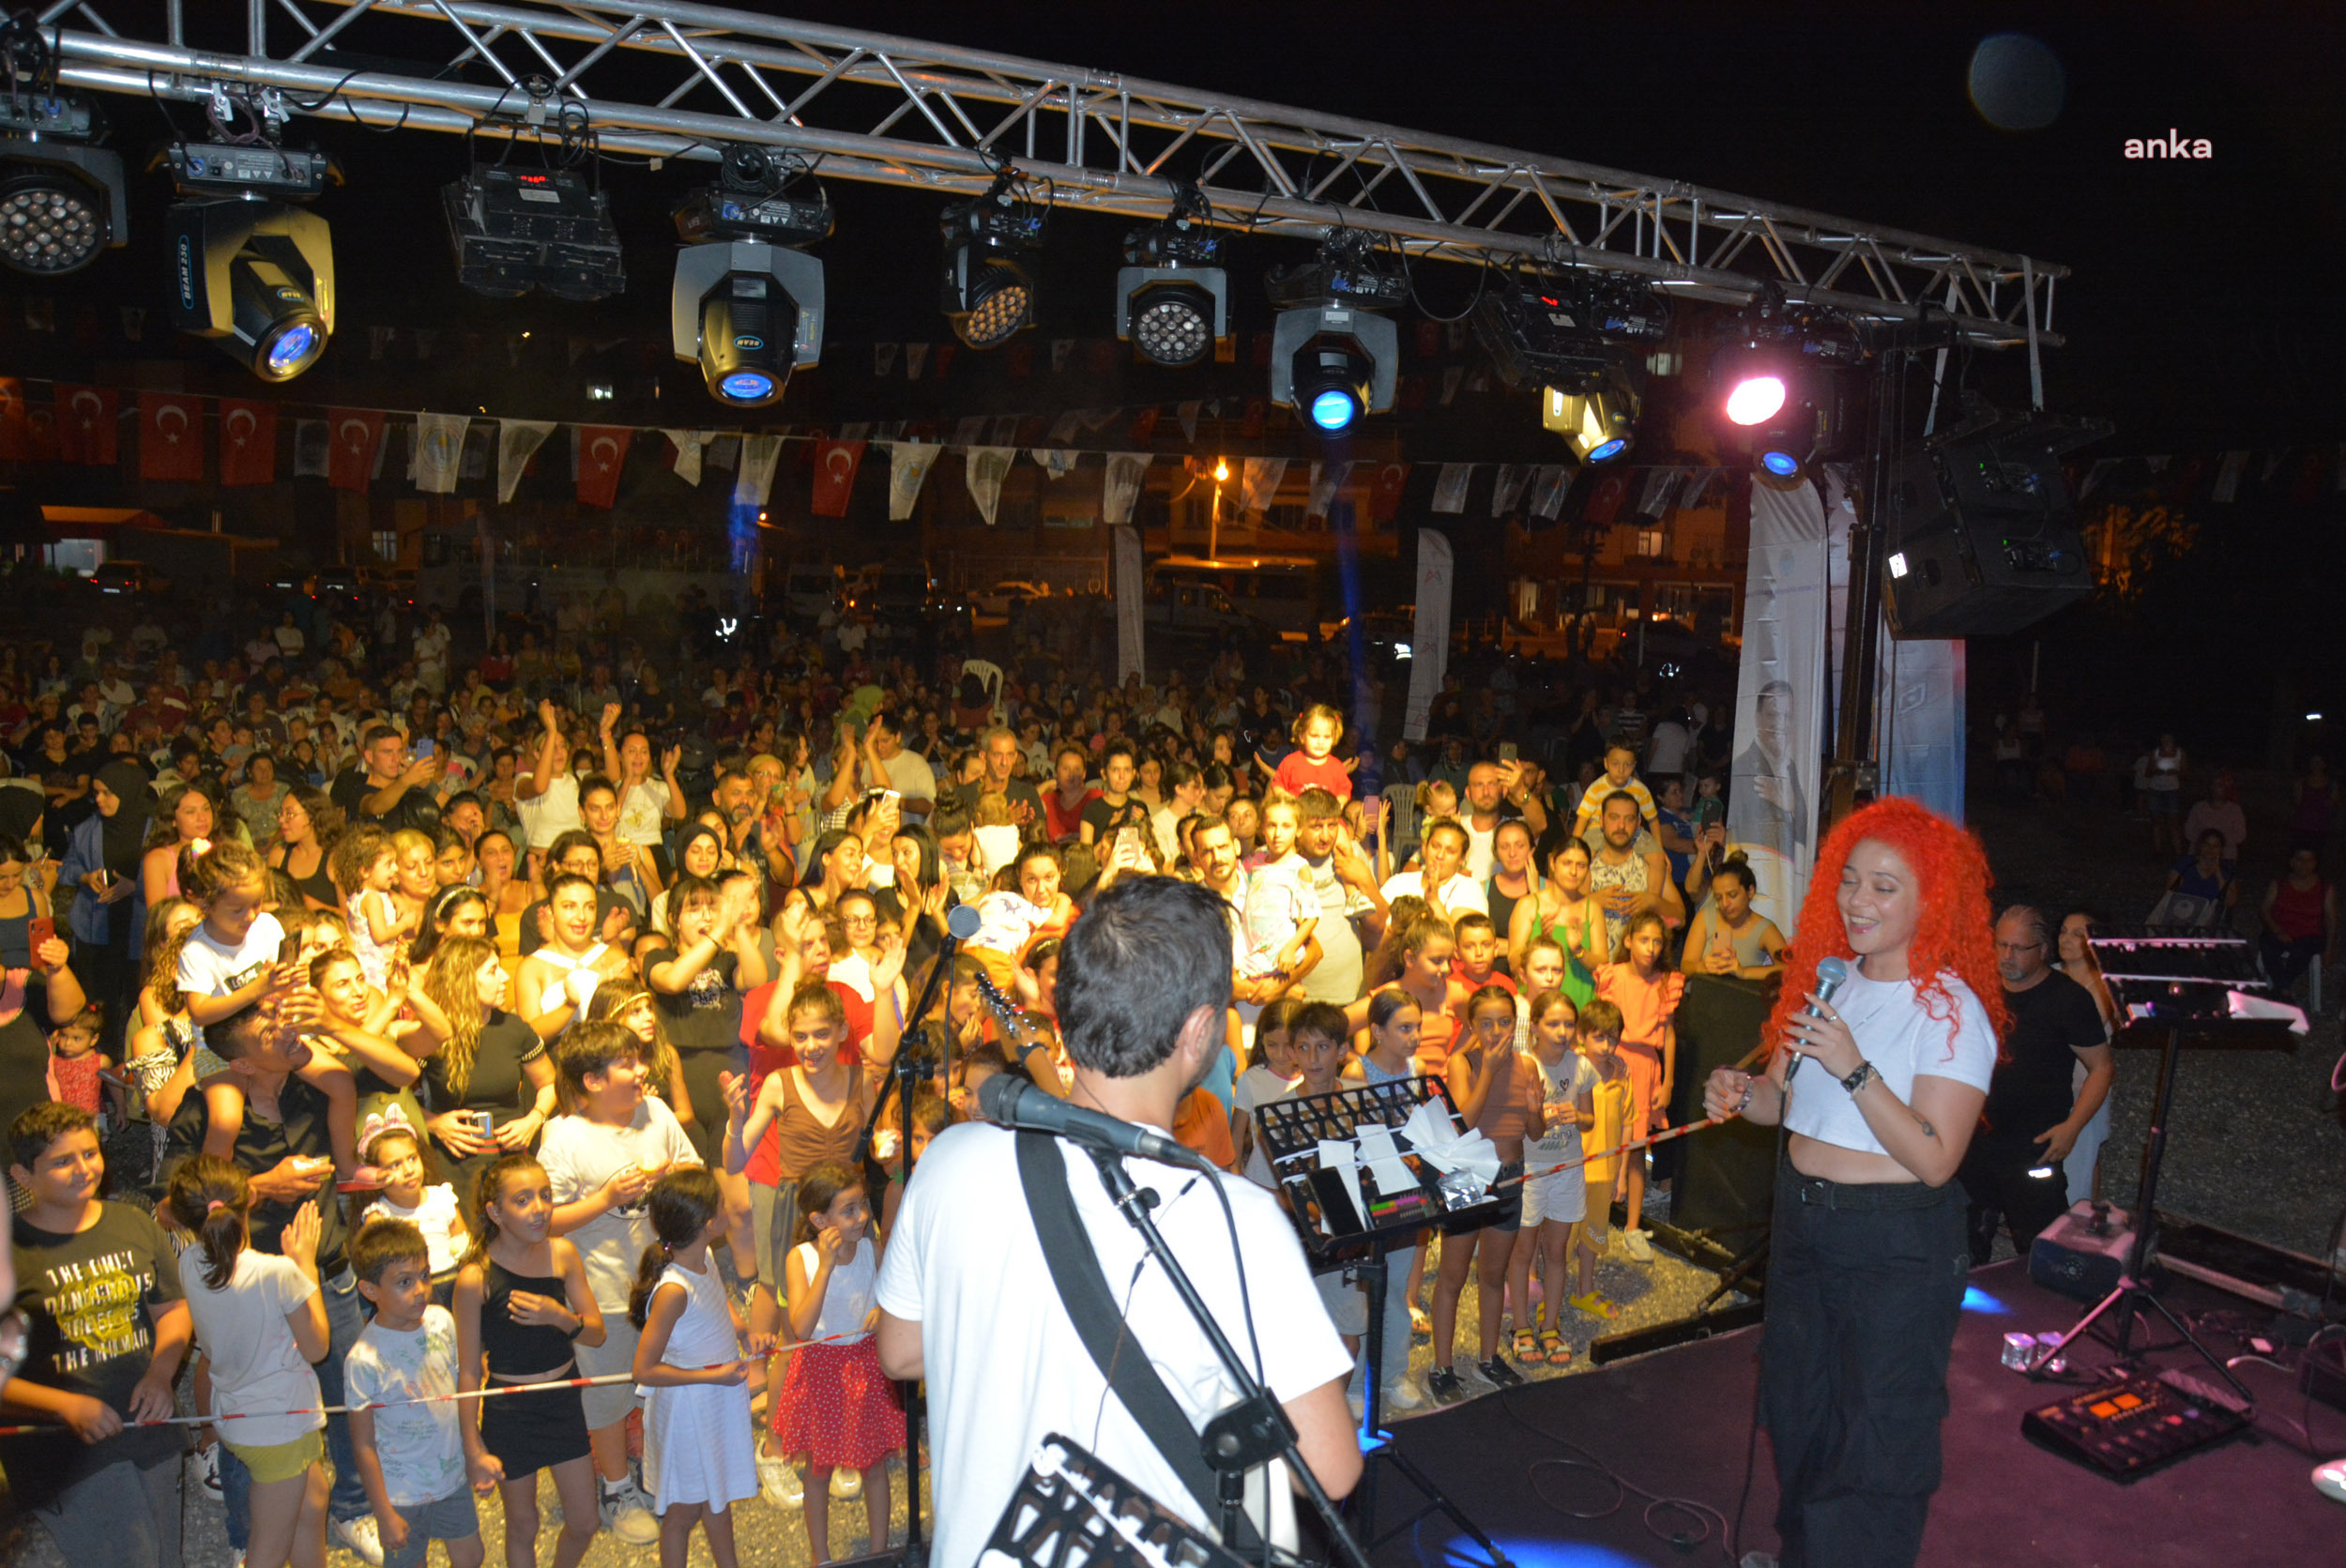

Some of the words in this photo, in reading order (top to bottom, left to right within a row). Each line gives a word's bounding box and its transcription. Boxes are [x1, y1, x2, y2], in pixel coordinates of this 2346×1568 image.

[181, 266, 191, 300] BEAM
[46, 1262, 84, 1287] THE
[52, 1347, 89, 1374] THE
